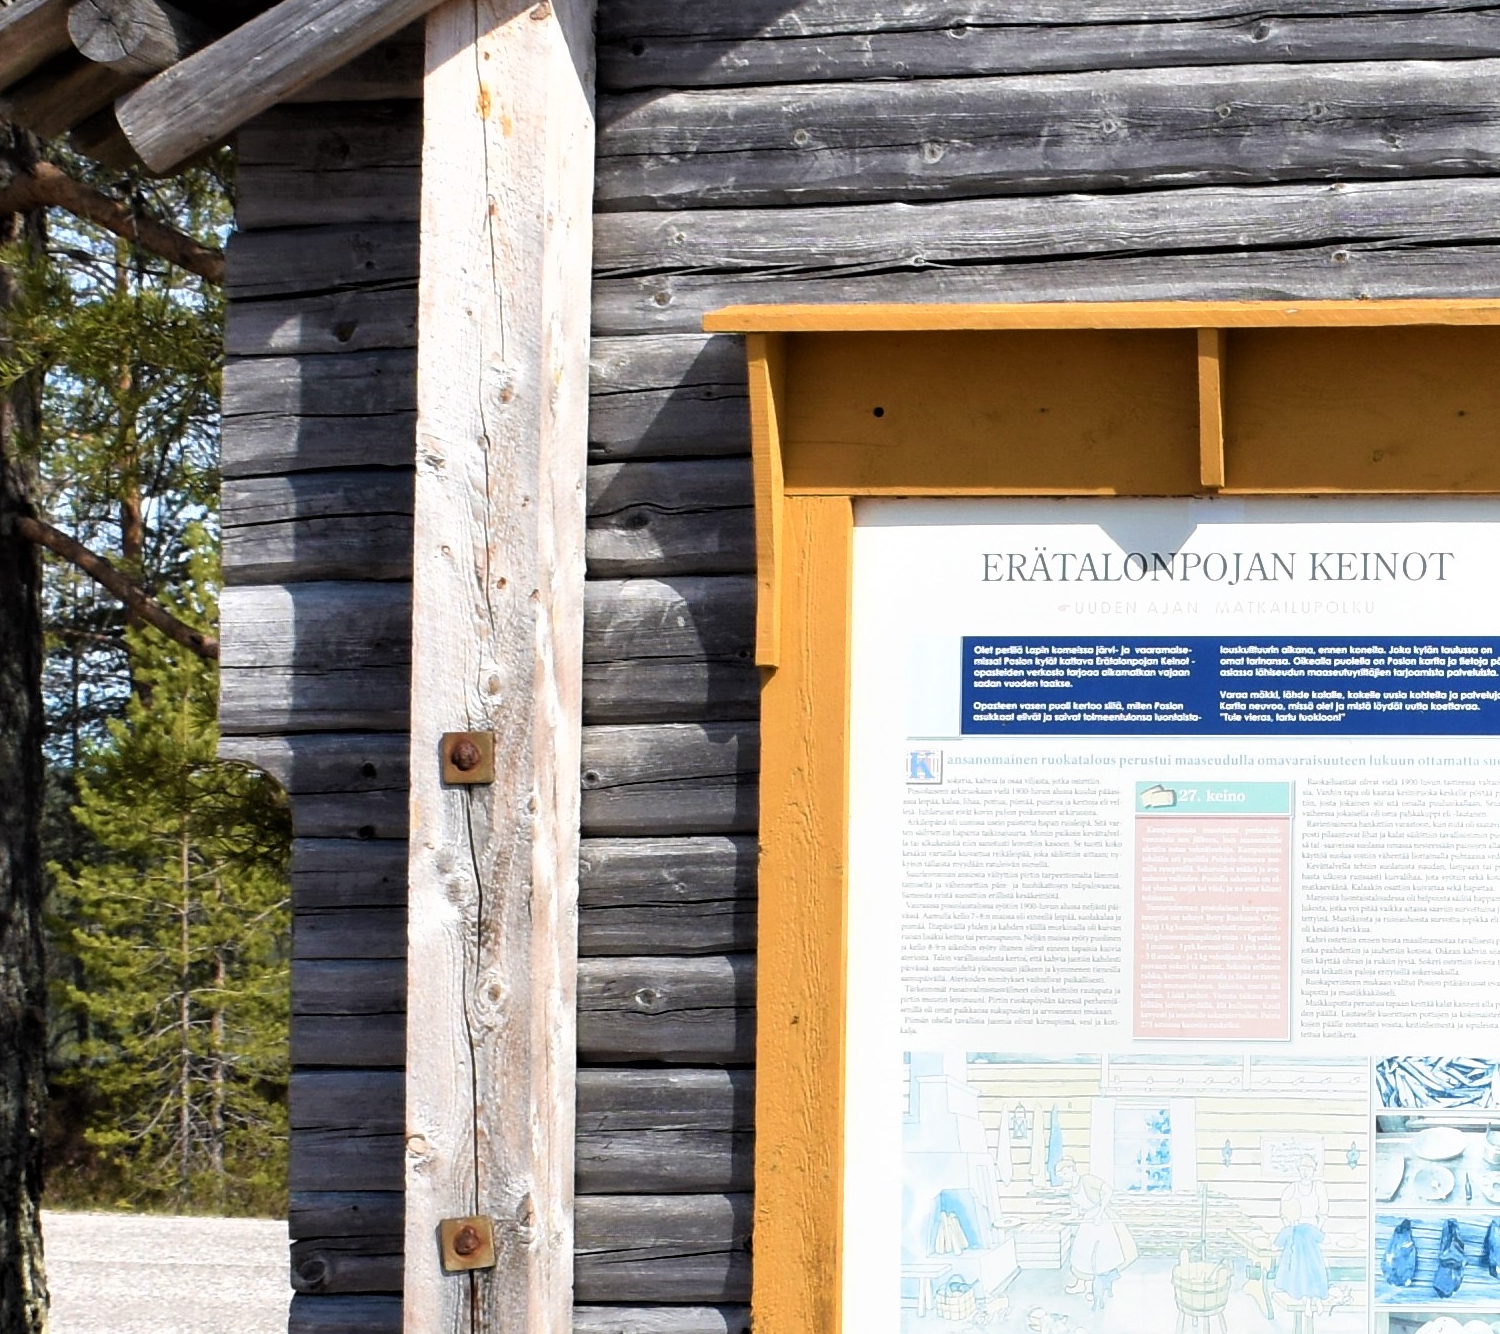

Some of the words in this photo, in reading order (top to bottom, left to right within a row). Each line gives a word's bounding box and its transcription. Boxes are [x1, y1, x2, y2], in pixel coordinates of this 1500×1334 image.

[981, 548, 1300, 586] ERÄTALONPOJAN
[1308, 551, 1458, 583] KEINOT
[1074, 600, 1138, 615] UUDEN
[1147, 600, 1198, 615] AJAN
[1214, 600, 1377, 615] MATKAILUPOLKU
[1041, 752, 1117, 766] ruokatalous
[1120, 753, 1172, 769] perustui
[1174, 753, 1255, 766] maaseudulla
[1257, 753, 1367, 766] omavaraisuuteen
[1369, 753, 1415, 766] lukuun
[1417, 754, 1480, 767] ottamatta
[1179, 789, 1201, 803] 27.
[1207, 789, 1246, 803] keino
